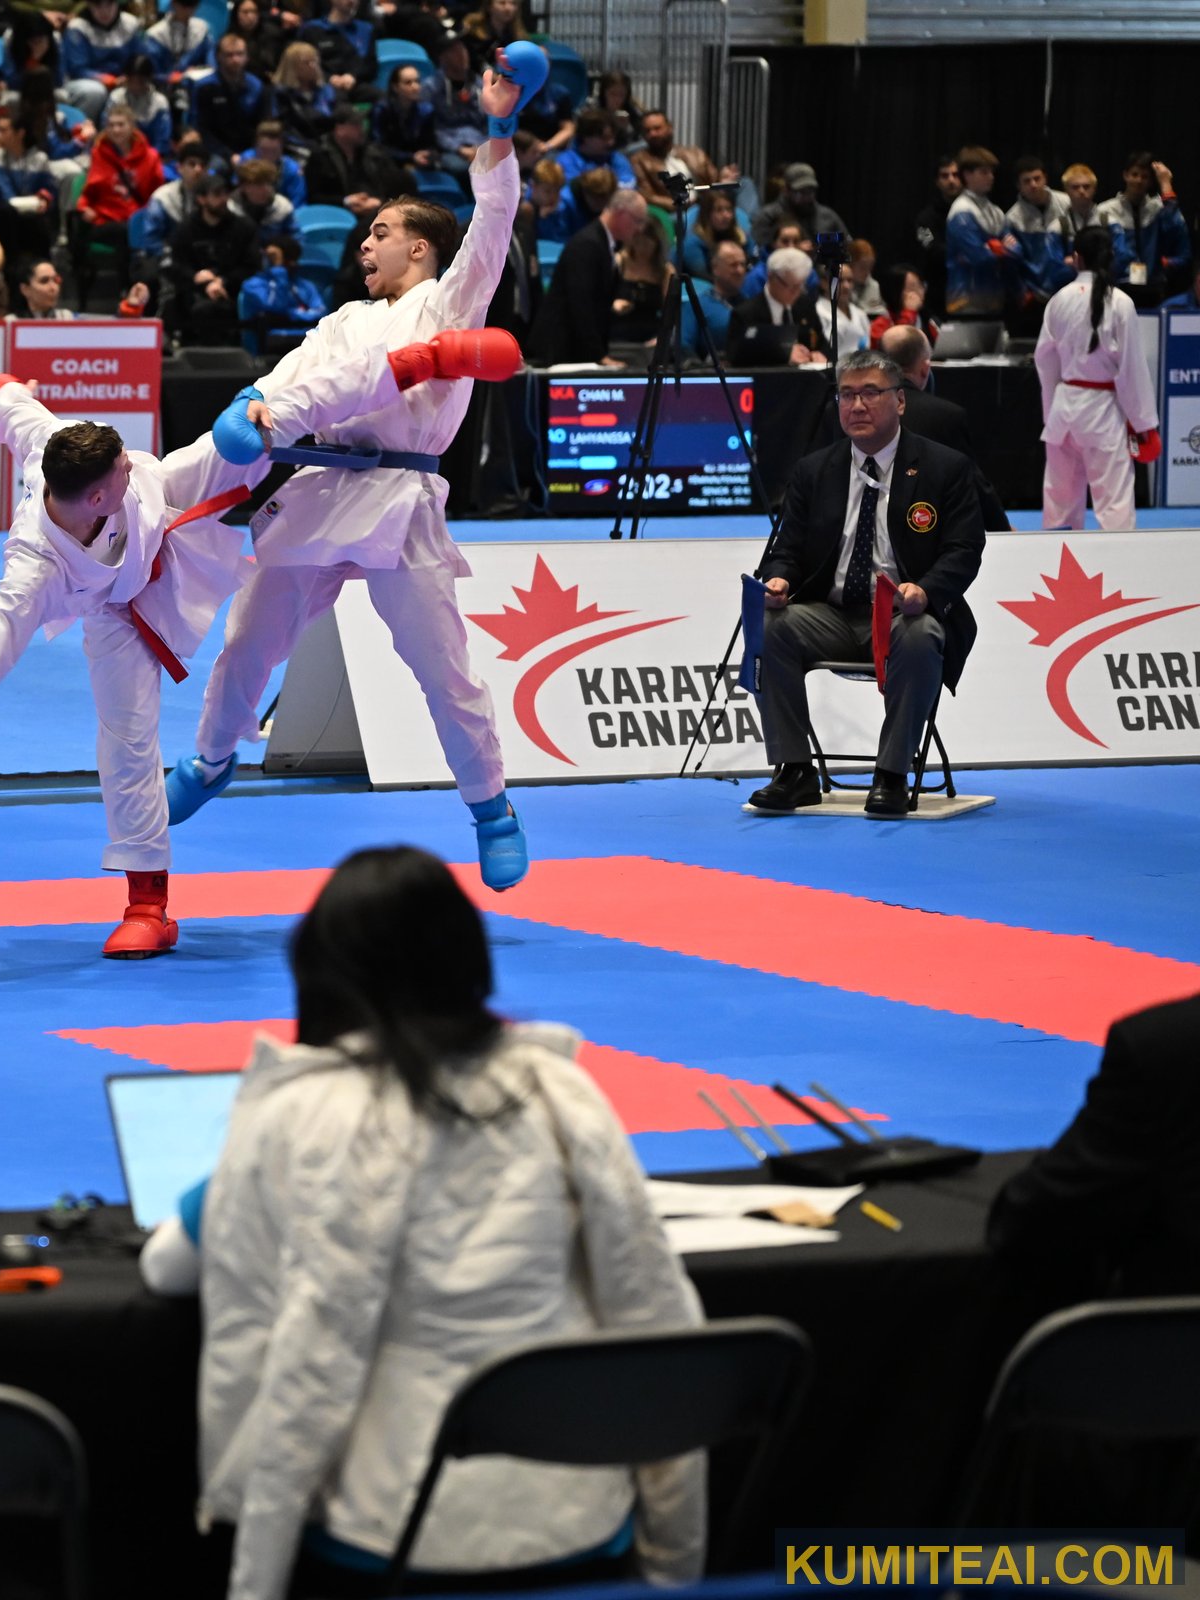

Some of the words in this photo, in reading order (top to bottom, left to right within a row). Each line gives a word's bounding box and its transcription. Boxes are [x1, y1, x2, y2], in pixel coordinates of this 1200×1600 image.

[51, 358, 118, 374] COACH
[575, 664, 749, 705] KARATE
[1103, 651, 1200, 690] KAR
[587, 707, 765, 748] CANADA
